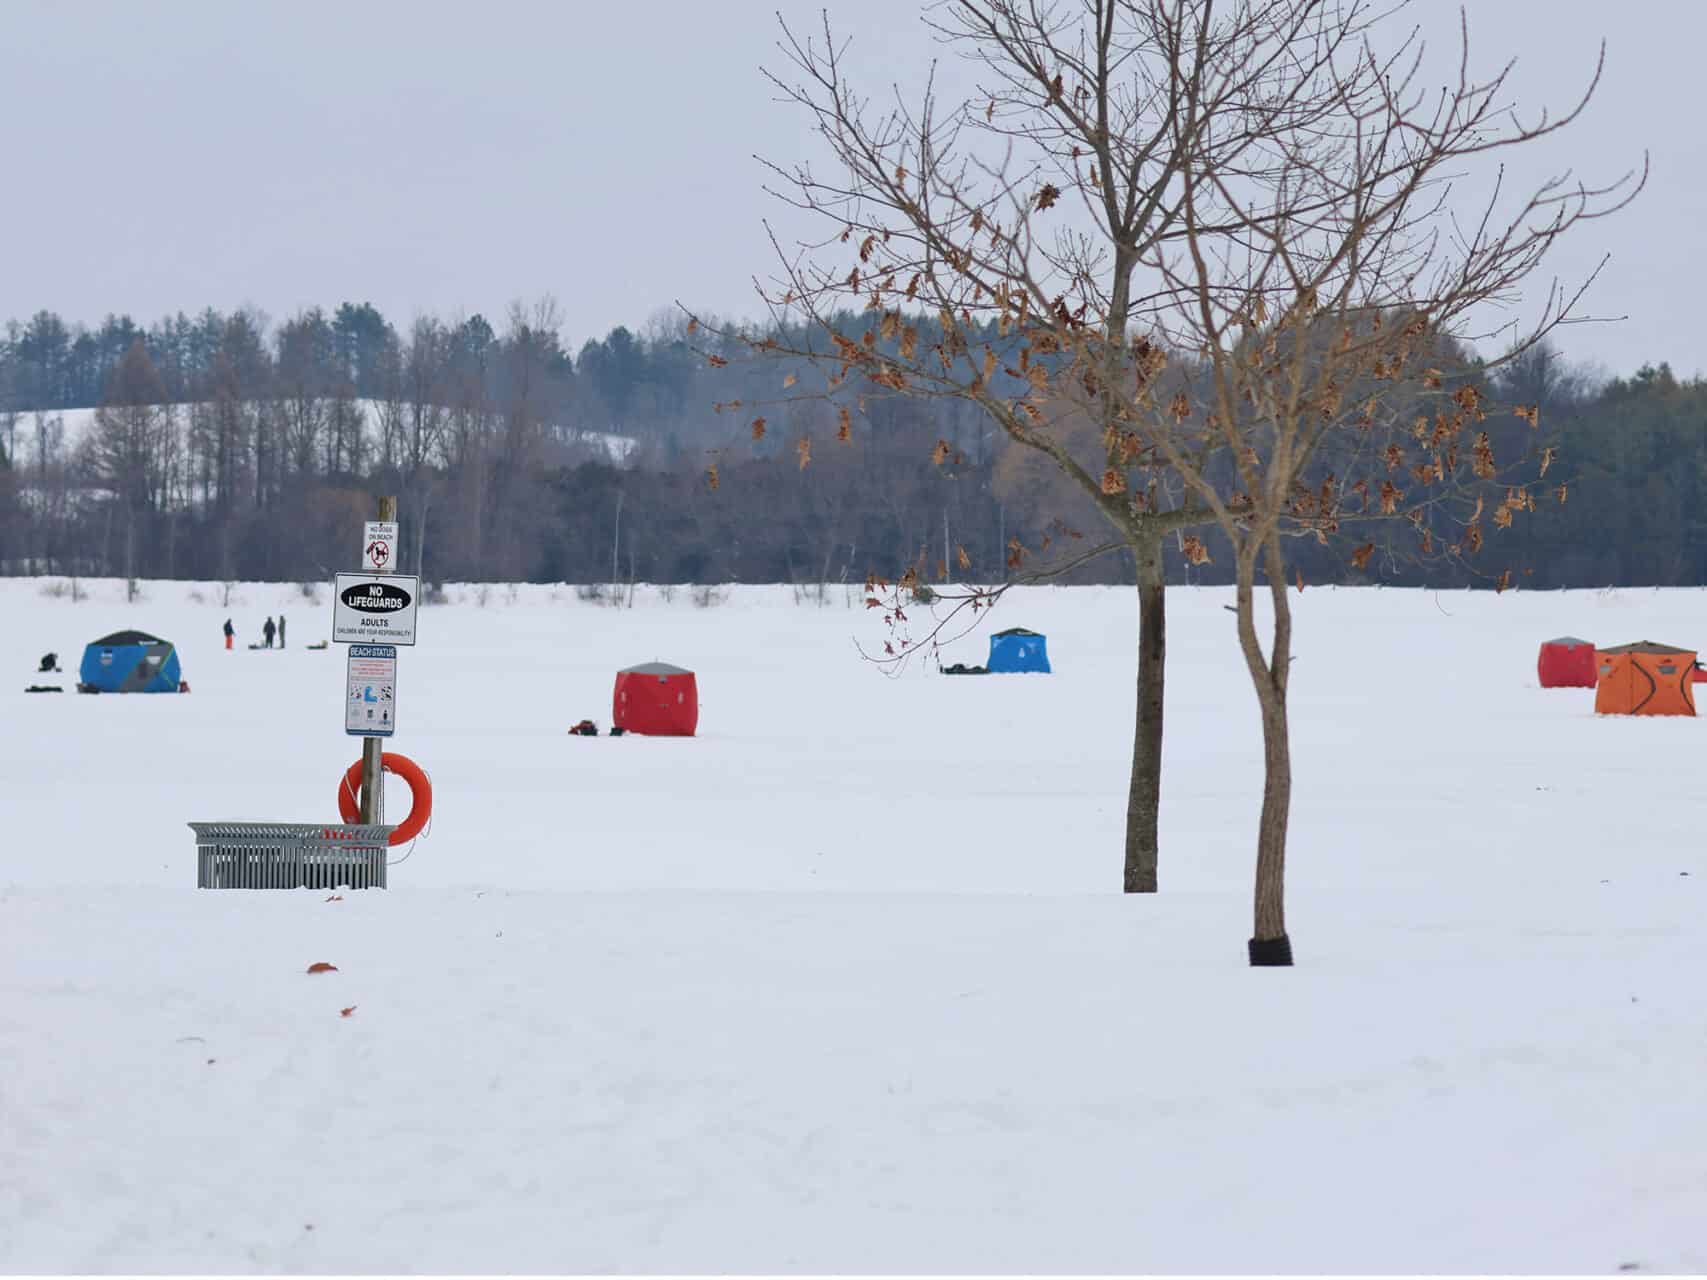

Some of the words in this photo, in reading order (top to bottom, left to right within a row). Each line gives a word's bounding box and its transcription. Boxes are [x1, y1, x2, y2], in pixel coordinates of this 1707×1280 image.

[369, 586, 383, 596] NO
[349, 596, 402, 608] LIFEGUARDS
[361, 618, 389, 627] ADULTS
[351, 647, 371, 657] BEACH
[372, 647, 395, 657] STATUS
